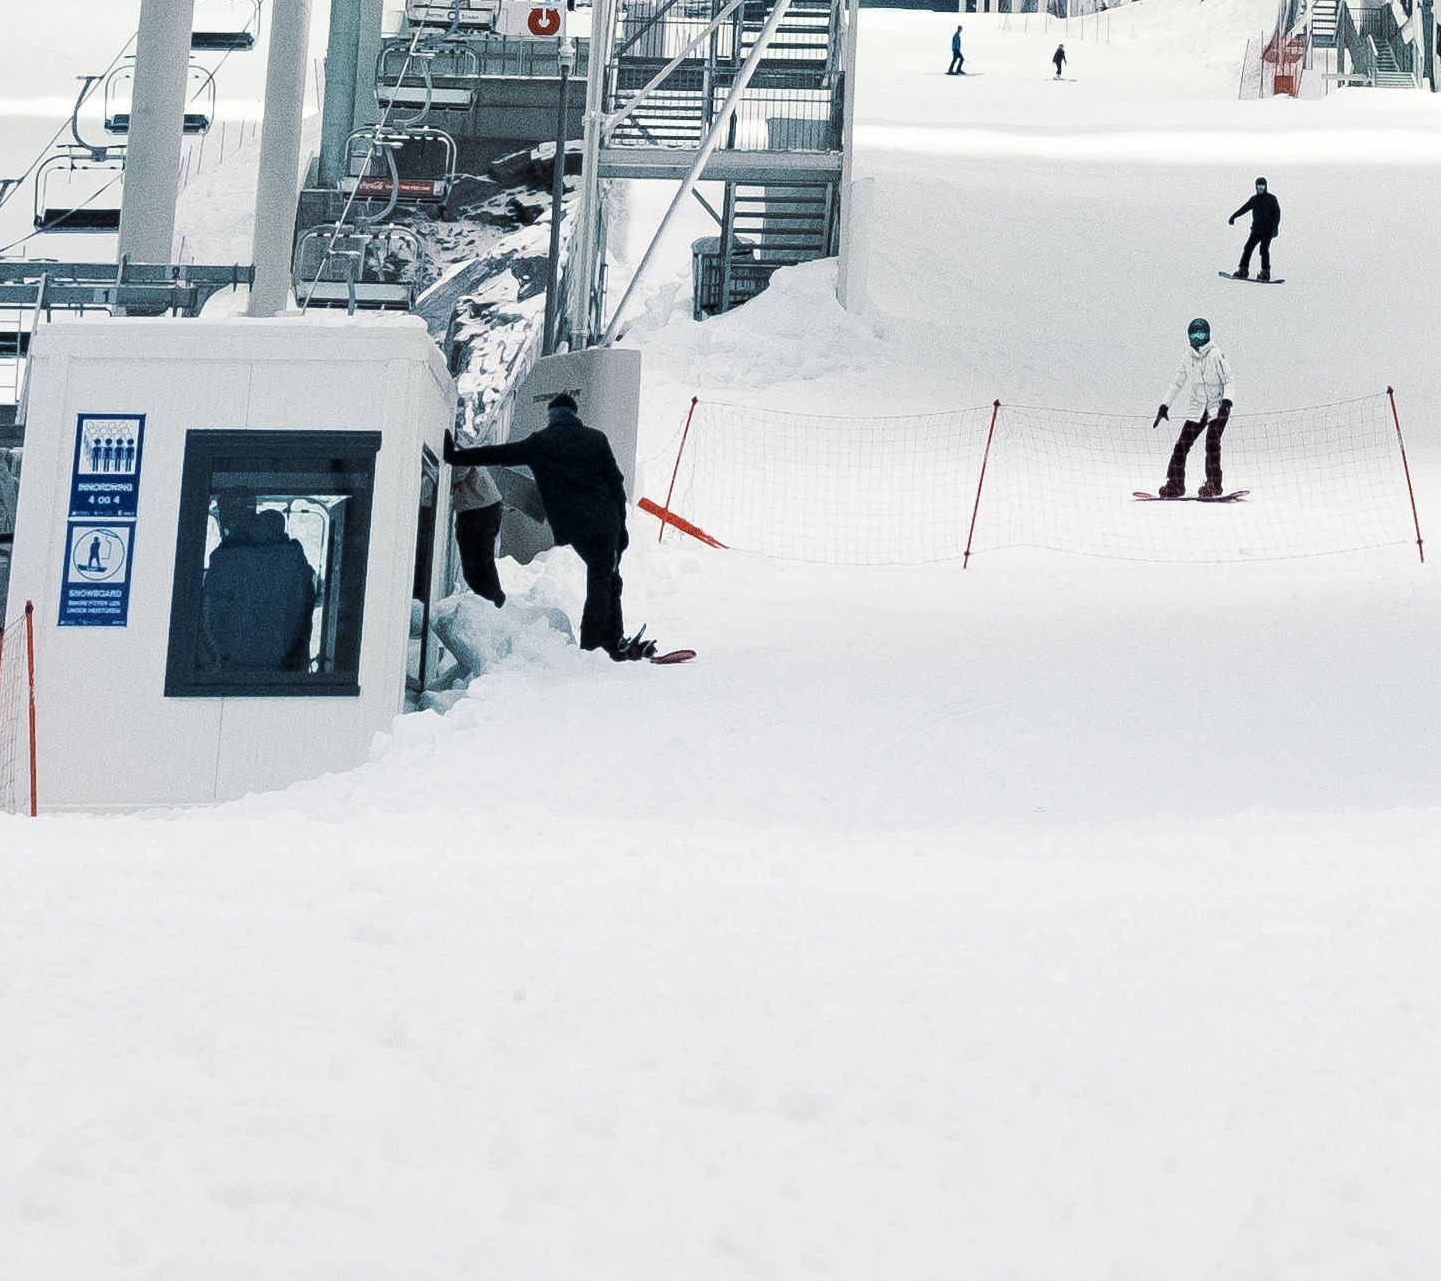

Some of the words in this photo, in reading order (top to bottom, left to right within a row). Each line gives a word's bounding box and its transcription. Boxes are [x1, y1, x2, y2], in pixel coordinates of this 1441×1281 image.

[88, 495, 95, 504] 4
[98, 496, 111, 504] OG
[113, 495, 120, 504] 4
[69, 589, 122, 598] SNOWBOARD
